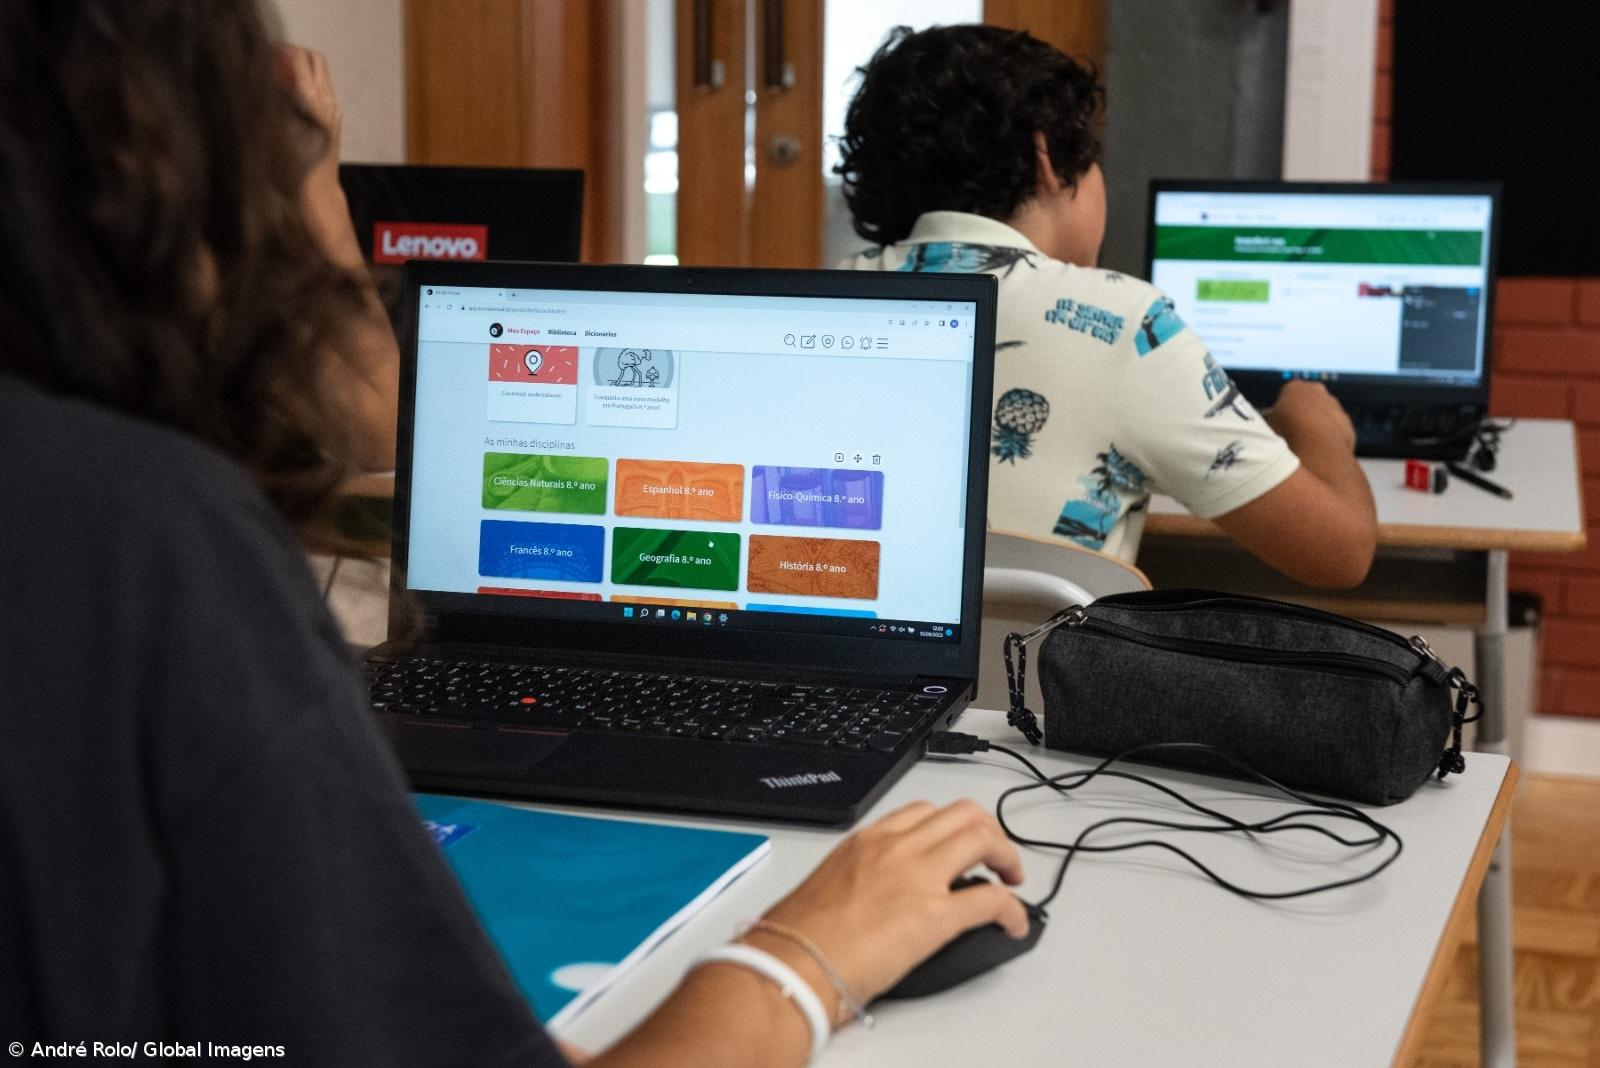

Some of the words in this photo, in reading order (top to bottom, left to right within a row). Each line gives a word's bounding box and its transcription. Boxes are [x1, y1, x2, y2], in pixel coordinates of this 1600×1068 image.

[382, 230, 478, 258] Lenovo
[548, 328, 577, 336] Biblioteca
[584, 330, 617, 338] Dicionários
[484, 436, 495, 446] As
[496, 438, 528, 448] minhas
[529, 438, 576, 450] disciplinas
[493, 476, 528, 487] Ciências
[530, 478, 566, 489] Naturais
[566, 481, 578, 490] 8.º
[579, 482, 596, 492] ano
[642, 484, 683, 496] Espanhol
[684, 486, 696, 496] 8.º
[698, 487, 714, 498] ano
[848, 496, 865, 504] ano
[510, 545, 542, 556] Francês
[543, 548, 555, 556] 8.º
[556, 548, 573, 558] ano
[639, 552, 680, 565] Geografia
[681, 556, 694, 564] 8.º
[695, 556, 712, 566] ano
[780, 560, 814, 572] História
[816, 563, 828, 573] 8.º
[829, 564, 847, 574] ano
[760, 771, 841, 789] ThinkPad
